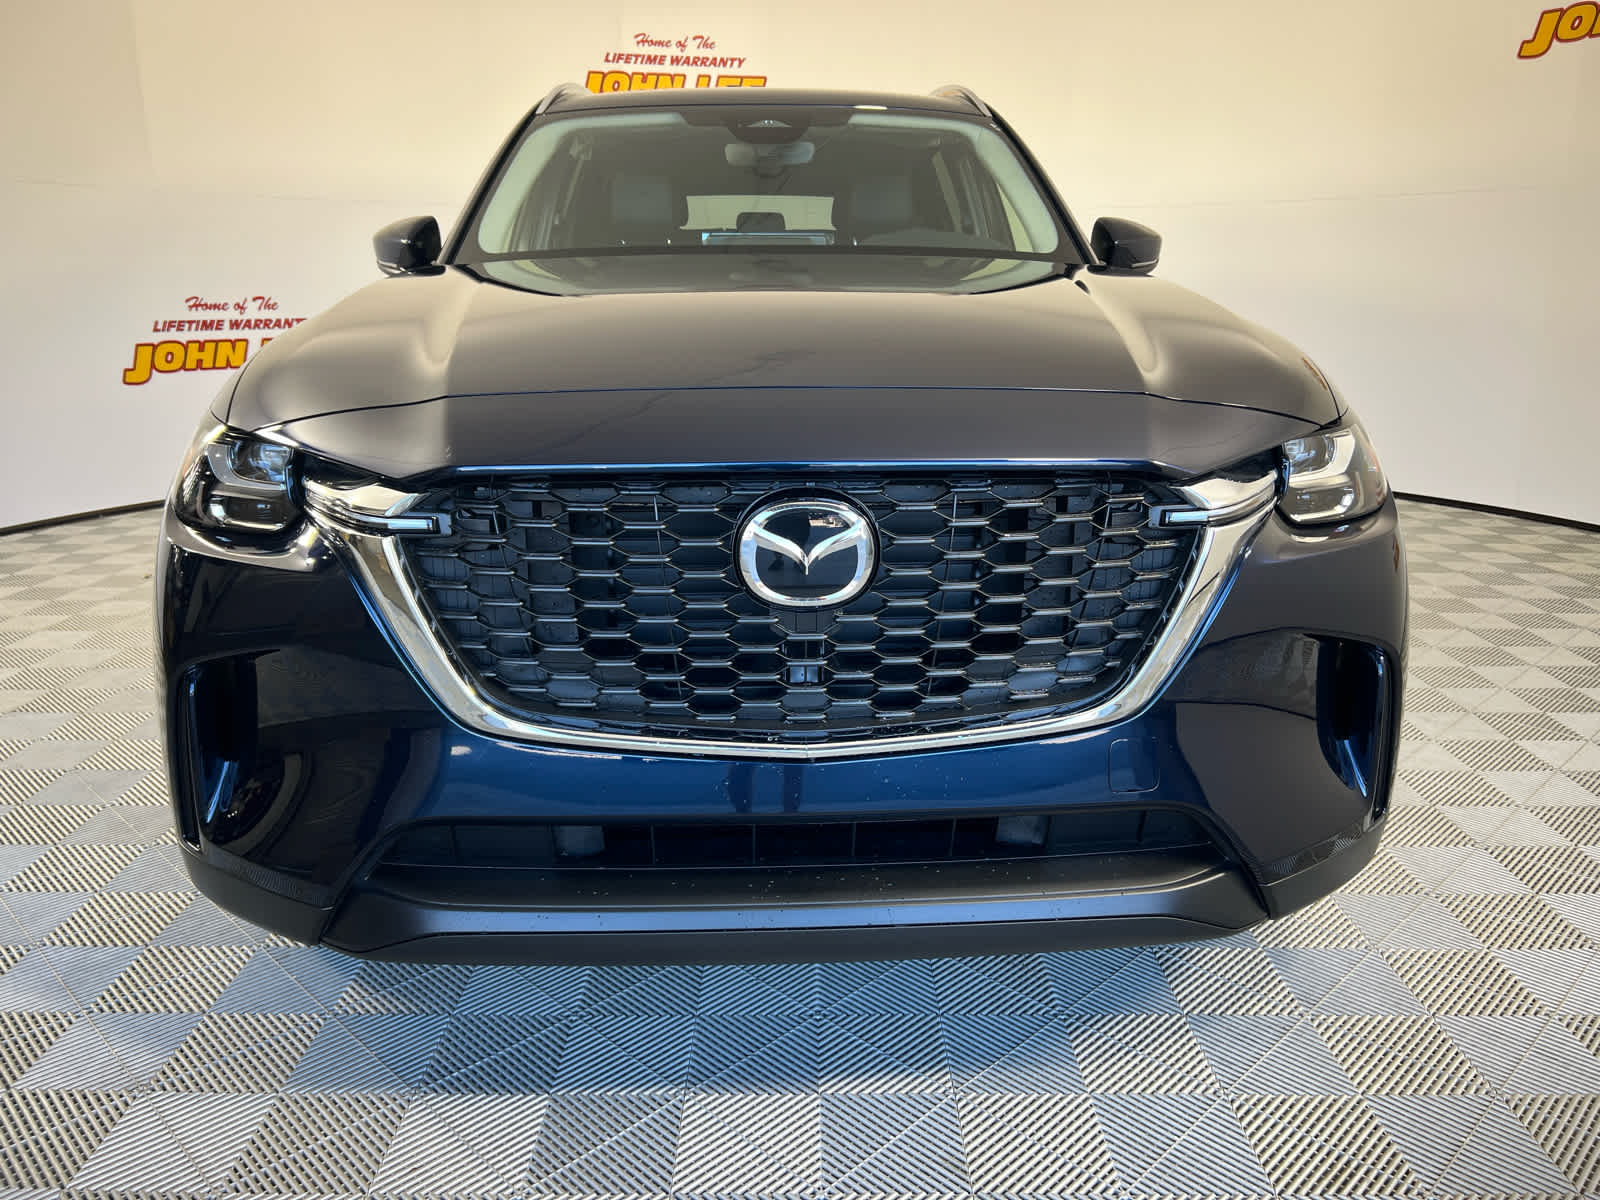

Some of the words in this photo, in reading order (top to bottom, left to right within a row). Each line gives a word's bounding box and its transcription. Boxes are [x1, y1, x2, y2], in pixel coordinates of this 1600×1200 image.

[1517, 0, 1600, 60] JO
[633, 32, 672, 48] Home
[675, 35, 690, 53] of
[692, 35, 716, 50] The
[604, 52, 666, 66] LIFETIME
[669, 55, 747, 69] WARRANTY
[184, 296, 230, 312] Home
[233, 297, 248, 315] of
[251, 296, 280, 312] The
[152, 319, 225, 333] LIFETIME
[228, 317, 307, 331] WARRANT
[122, 338, 249, 386] JOHN
